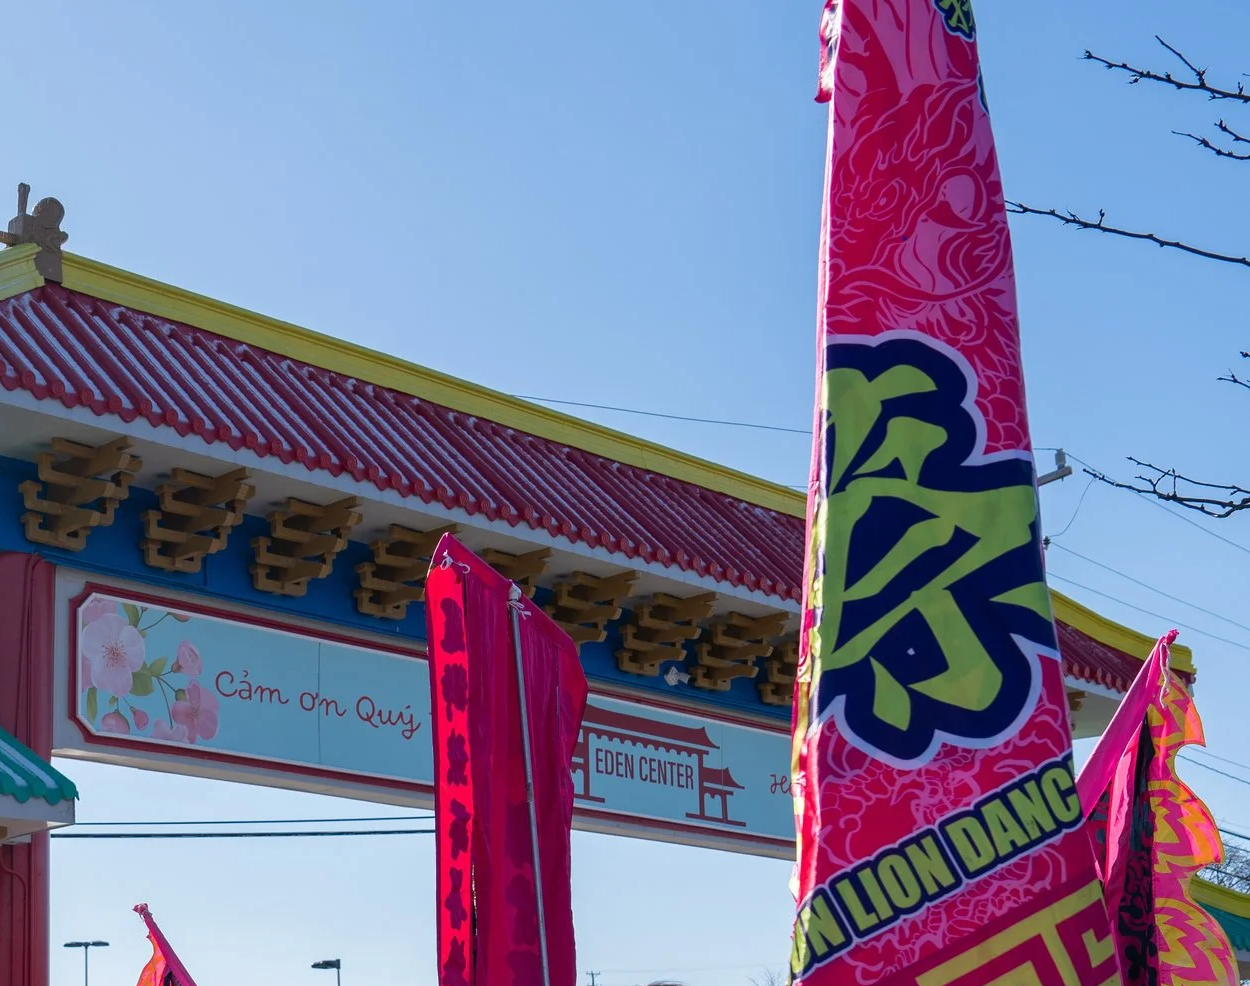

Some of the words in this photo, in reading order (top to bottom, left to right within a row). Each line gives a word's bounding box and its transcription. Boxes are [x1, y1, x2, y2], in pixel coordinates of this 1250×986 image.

[215, 669, 290, 705] Cảm
[299, 690, 347, 717] ơn
[355, 695, 422, 740] Quý
[595, 748, 635, 780] EDEN
[639, 755, 694, 790] CENTER
[835, 835, 956, 932] LION
[945, 759, 1081, 873] DANC
